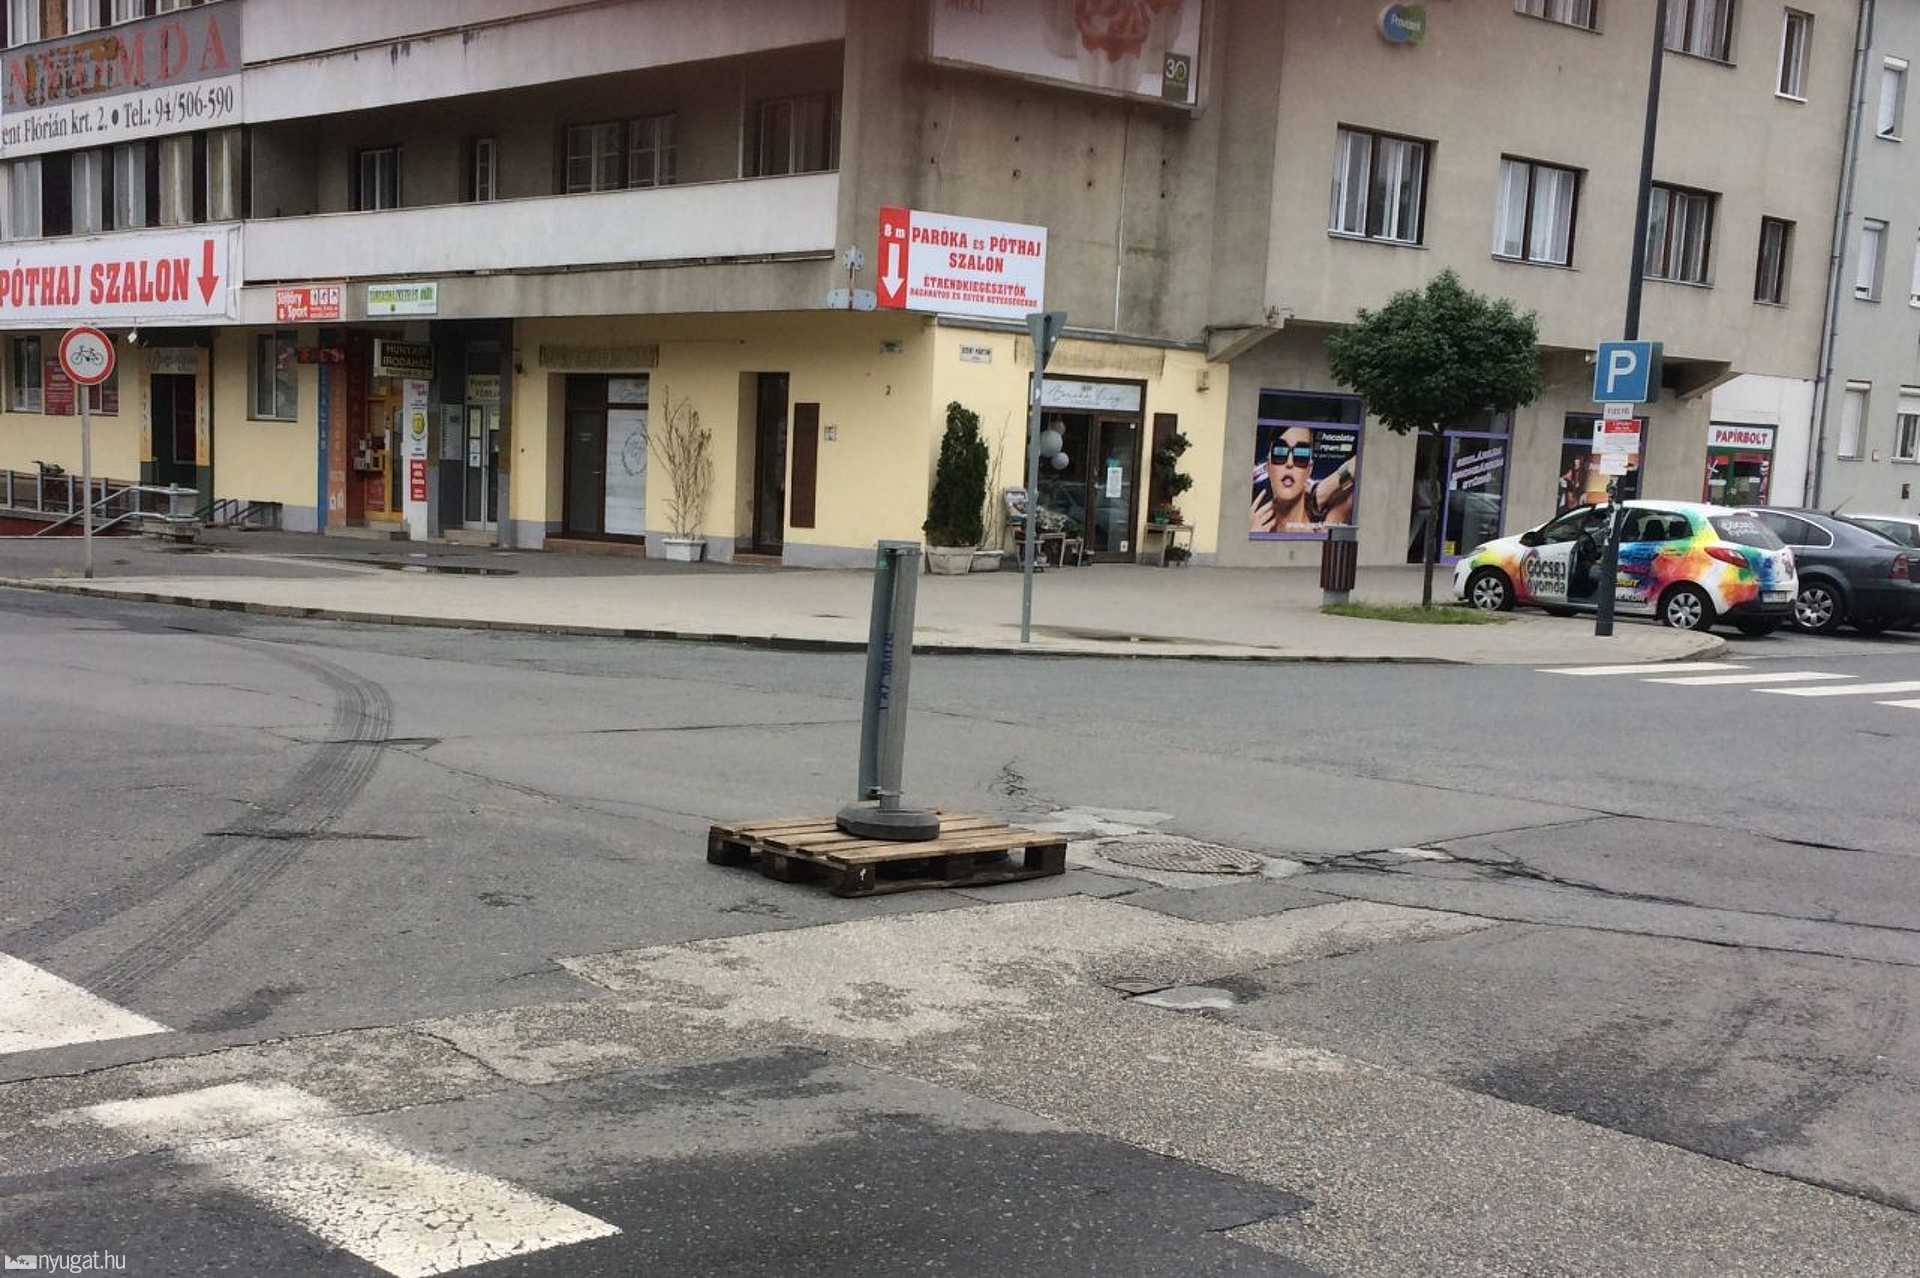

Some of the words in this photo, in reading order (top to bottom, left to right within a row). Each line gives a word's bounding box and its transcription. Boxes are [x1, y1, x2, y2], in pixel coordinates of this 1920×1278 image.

[24, 112, 67, 142] Flórián
[72, 109, 92, 133] krt.
[97, 107, 108, 131] 2.
[123, 101, 151, 128] Tel.:
[155, 86, 234, 127] 94/506-590
[912, 226, 968, 249] PARÓKA
[990, 234, 1041, 257] PÓTHAJ
[949, 252, 1005, 273] SZALON
[0, 258, 81, 308] PÓTHAJ
[90, 257, 190, 305] SZALON
[1606, 350, 1638, 393] P
[1715, 428, 1768, 446] PAPÍRBOLT
